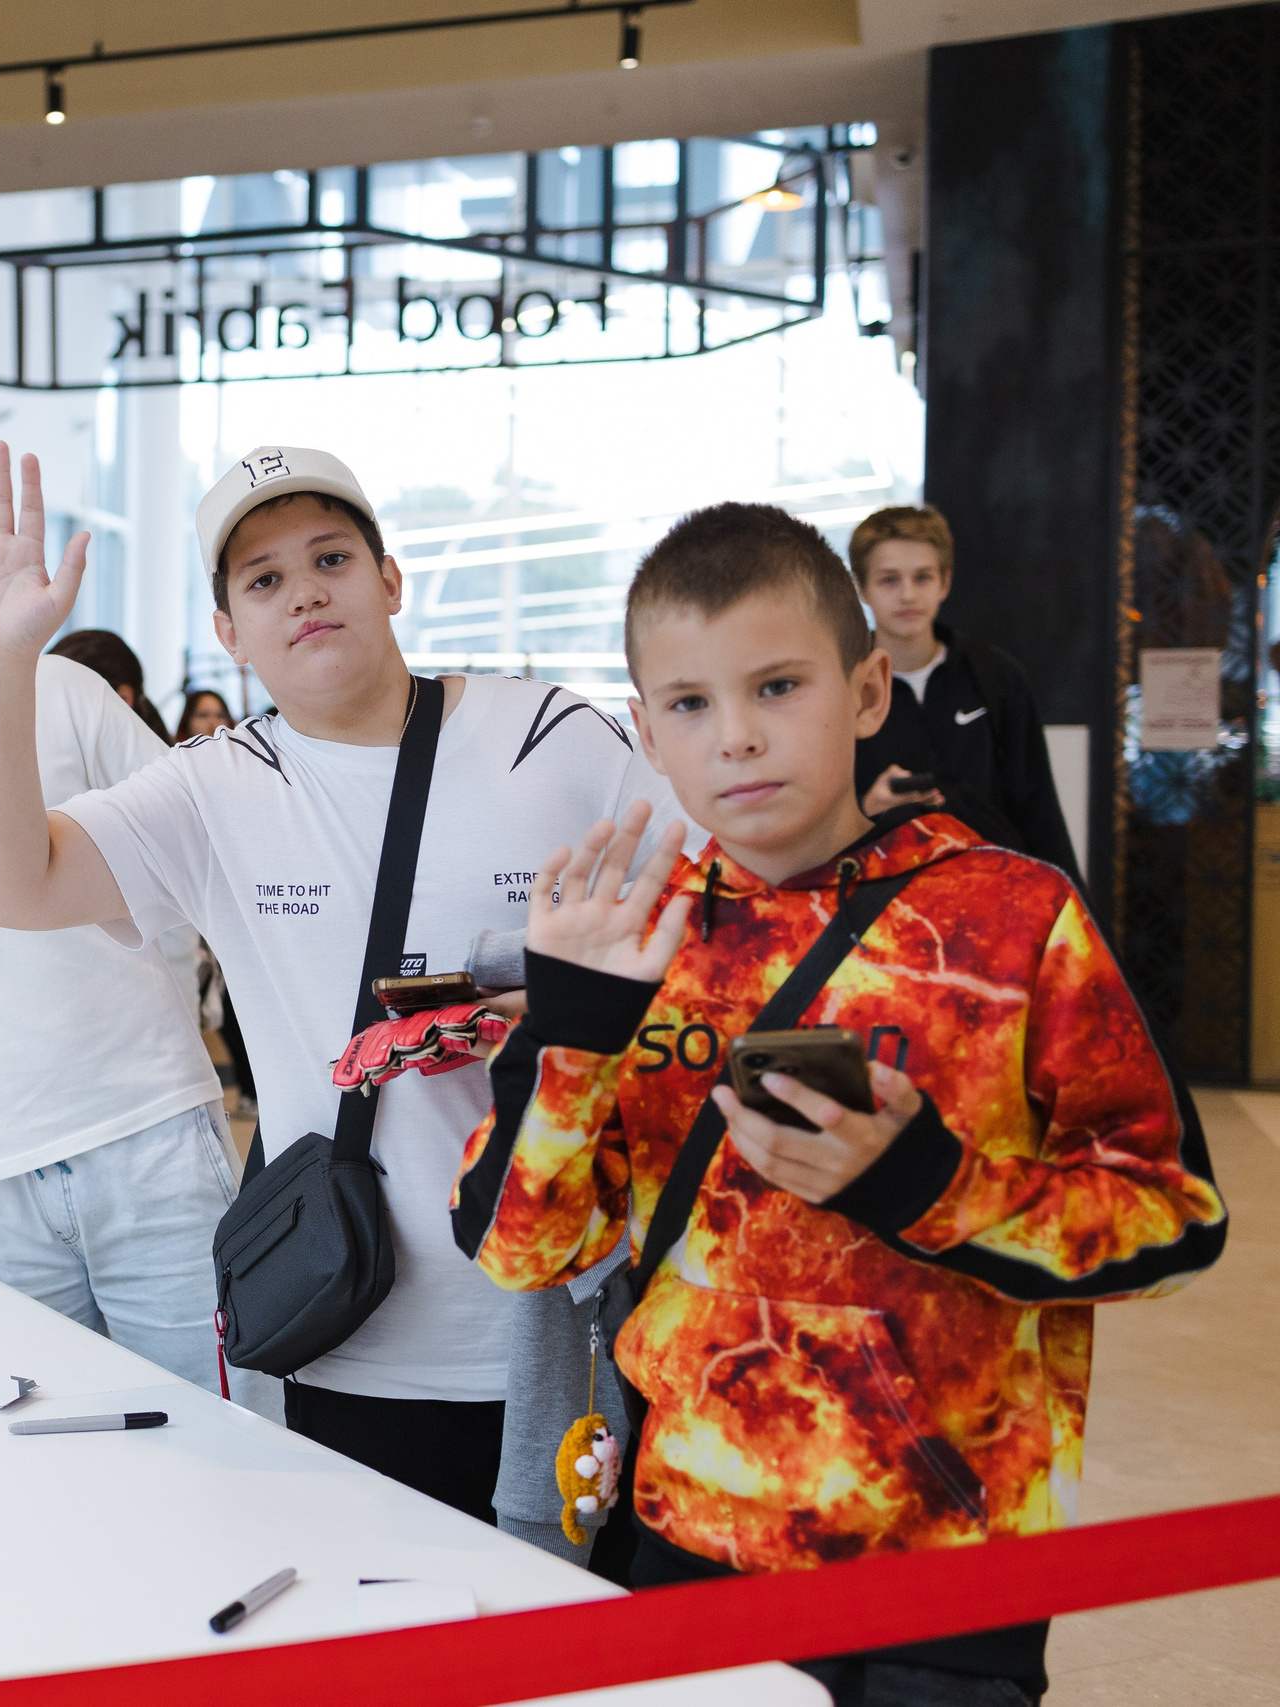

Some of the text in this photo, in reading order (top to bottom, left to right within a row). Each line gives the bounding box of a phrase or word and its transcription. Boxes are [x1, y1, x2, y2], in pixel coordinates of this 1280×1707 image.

[493, 872, 560, 886] EXTR
[255, 884, 331, 897] TIME TO HIT
[256, 902, 320, 915] THE ROAD
